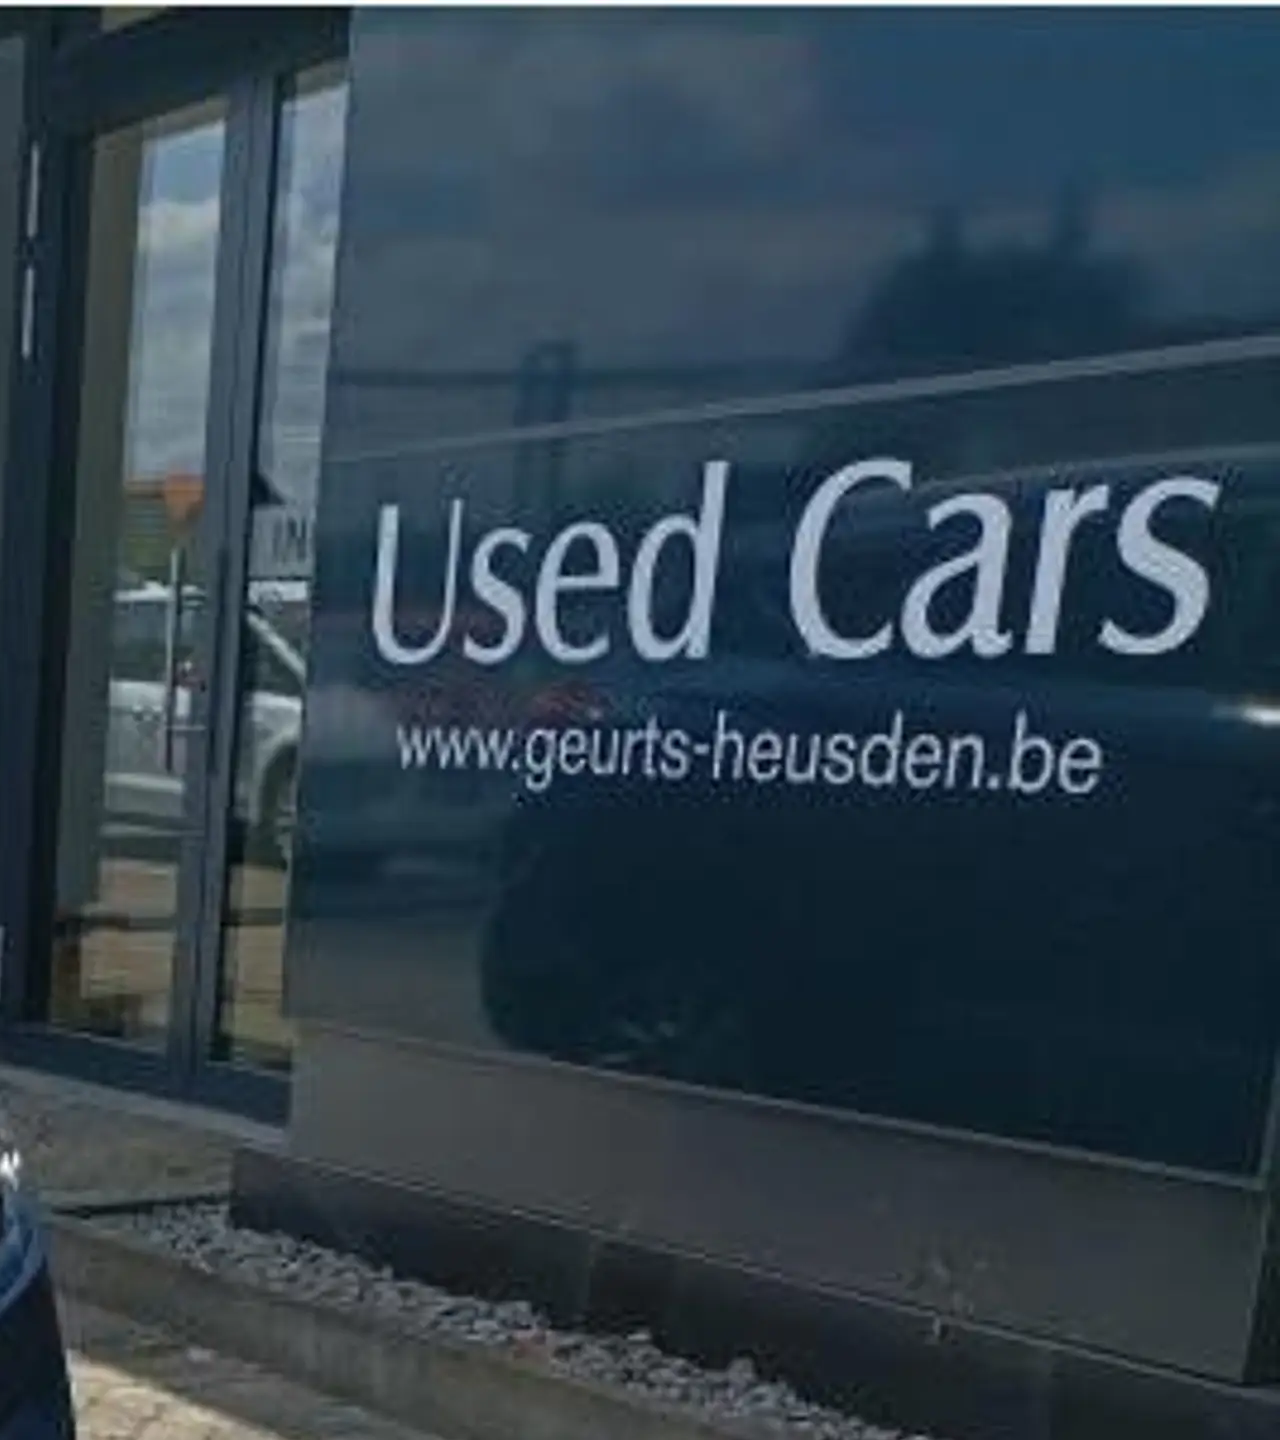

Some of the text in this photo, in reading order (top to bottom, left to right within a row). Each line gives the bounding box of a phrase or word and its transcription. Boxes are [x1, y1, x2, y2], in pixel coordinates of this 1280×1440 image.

[371, 456, 1221, 666] Used Cars
[396, 709, 1103, 795] www.geurts-heusden.be
